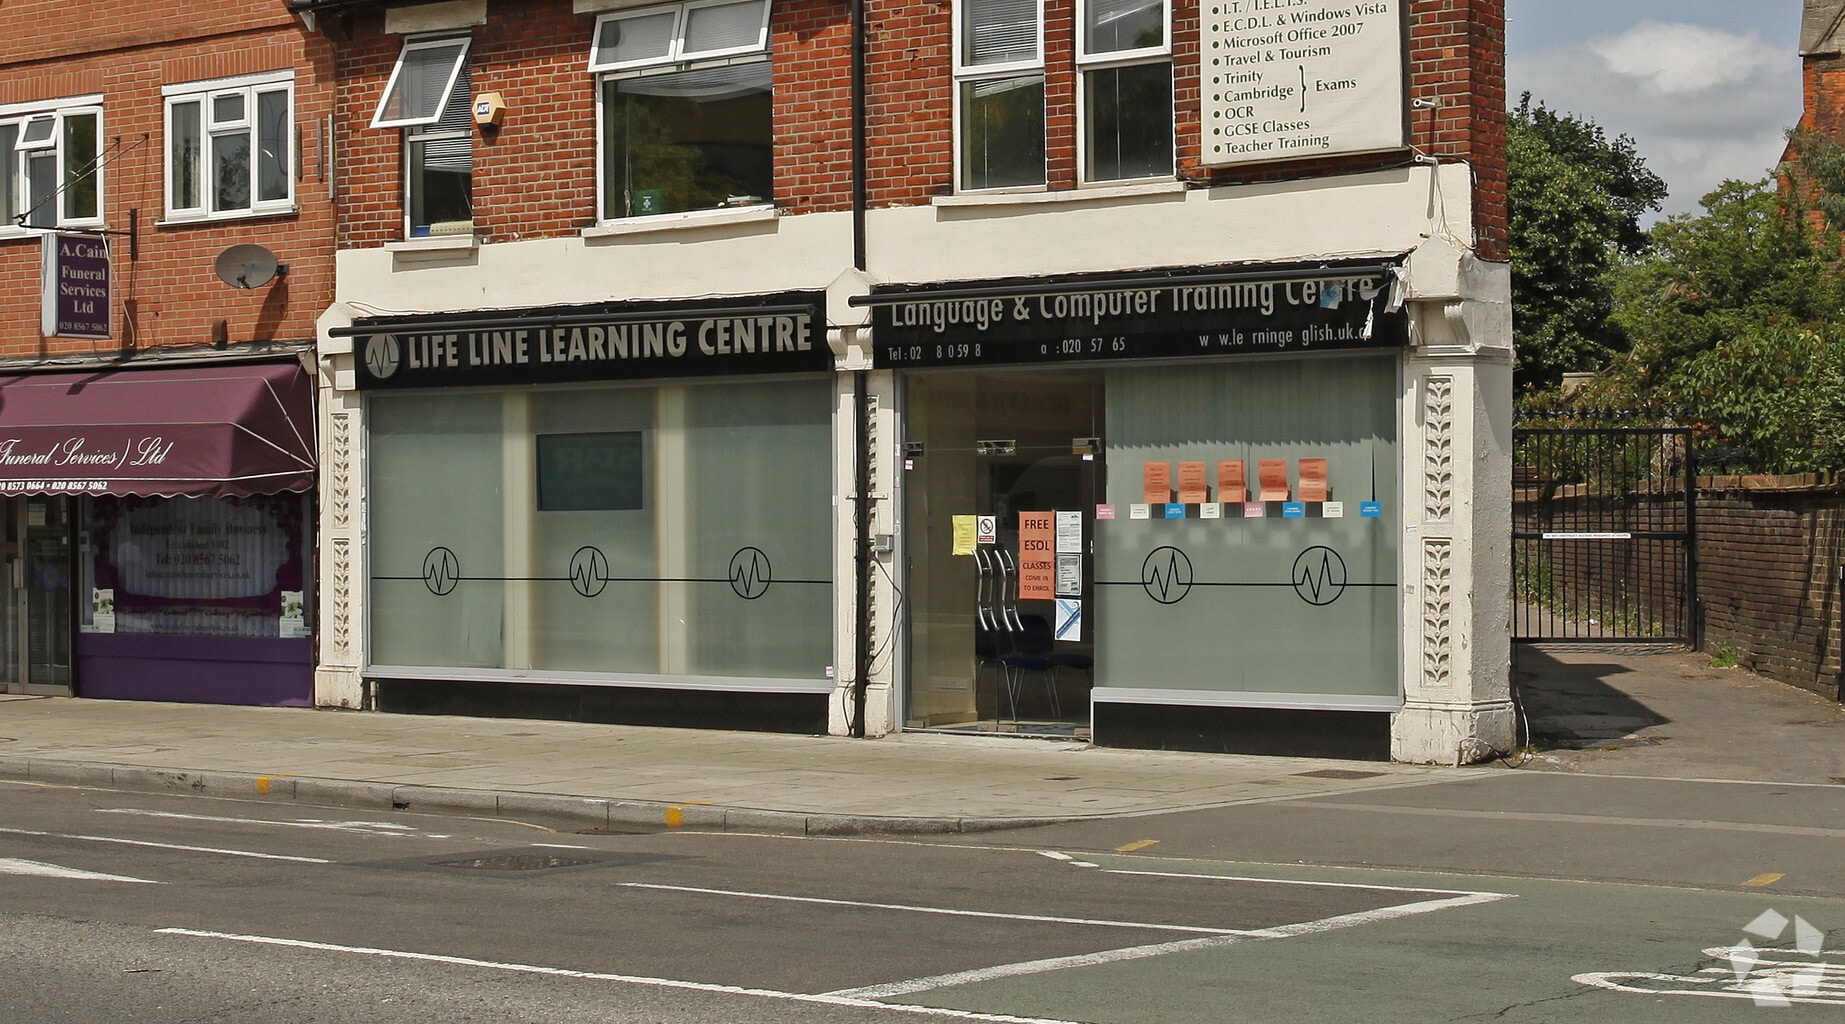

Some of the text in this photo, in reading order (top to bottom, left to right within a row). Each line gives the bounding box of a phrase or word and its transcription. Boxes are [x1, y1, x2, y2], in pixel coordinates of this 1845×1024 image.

[1224, 2, 1242, 14] I.T.
[1246, 0, 1250, 13] /
[1224, 2, 1388, 32] E.C.D.L. & Windows Vista
[1224, 22, 1364, 49] Microsoft Office 2007
[1224, 45, 1331, 66] Travel & Tourism
[1224, 70, 1264, 85] Trinity
[1316, 79, 1356, 92] Exams
[1224, 85, 1294, 102] Cambridge
[1225, 106, 1254, 120] OCR
[1225, 120, 1310, 137] GCSE Classes
[1225, 134, 1330, 154] Teacher Training
[62, 265, 106, 281] Funeral
[60, 282, 106, 298] Services
[74, 300, 94, 314] Ltd
[892, 298, 1003, 333] Language
[1013, 296, 1030, 320] &
[1040, 287, 1161, 325] Computer
[60, 322, 72, 330] 020
[409, 314, 812, 369] LIFE LINE LEARNING CENTRE
[130, 436, 174, 466] Ltd
[7, 481, 25, 490] 8573
[26, 481, 45, 490] 0664
[52, 481, 66, 490] 020
[67, 481, 86, 490] 8567
[88, 481, 108, 490] 5062
[130, 522, 267, 538] Independent Family Business
[1024, 519, 1049, 530] FREE
[1024, 540, 1050, 550] ESOL
[156, 553, 240, 566] Tel: 020 8567 5062
[1022, 562, 1051, 570] CLASSES
